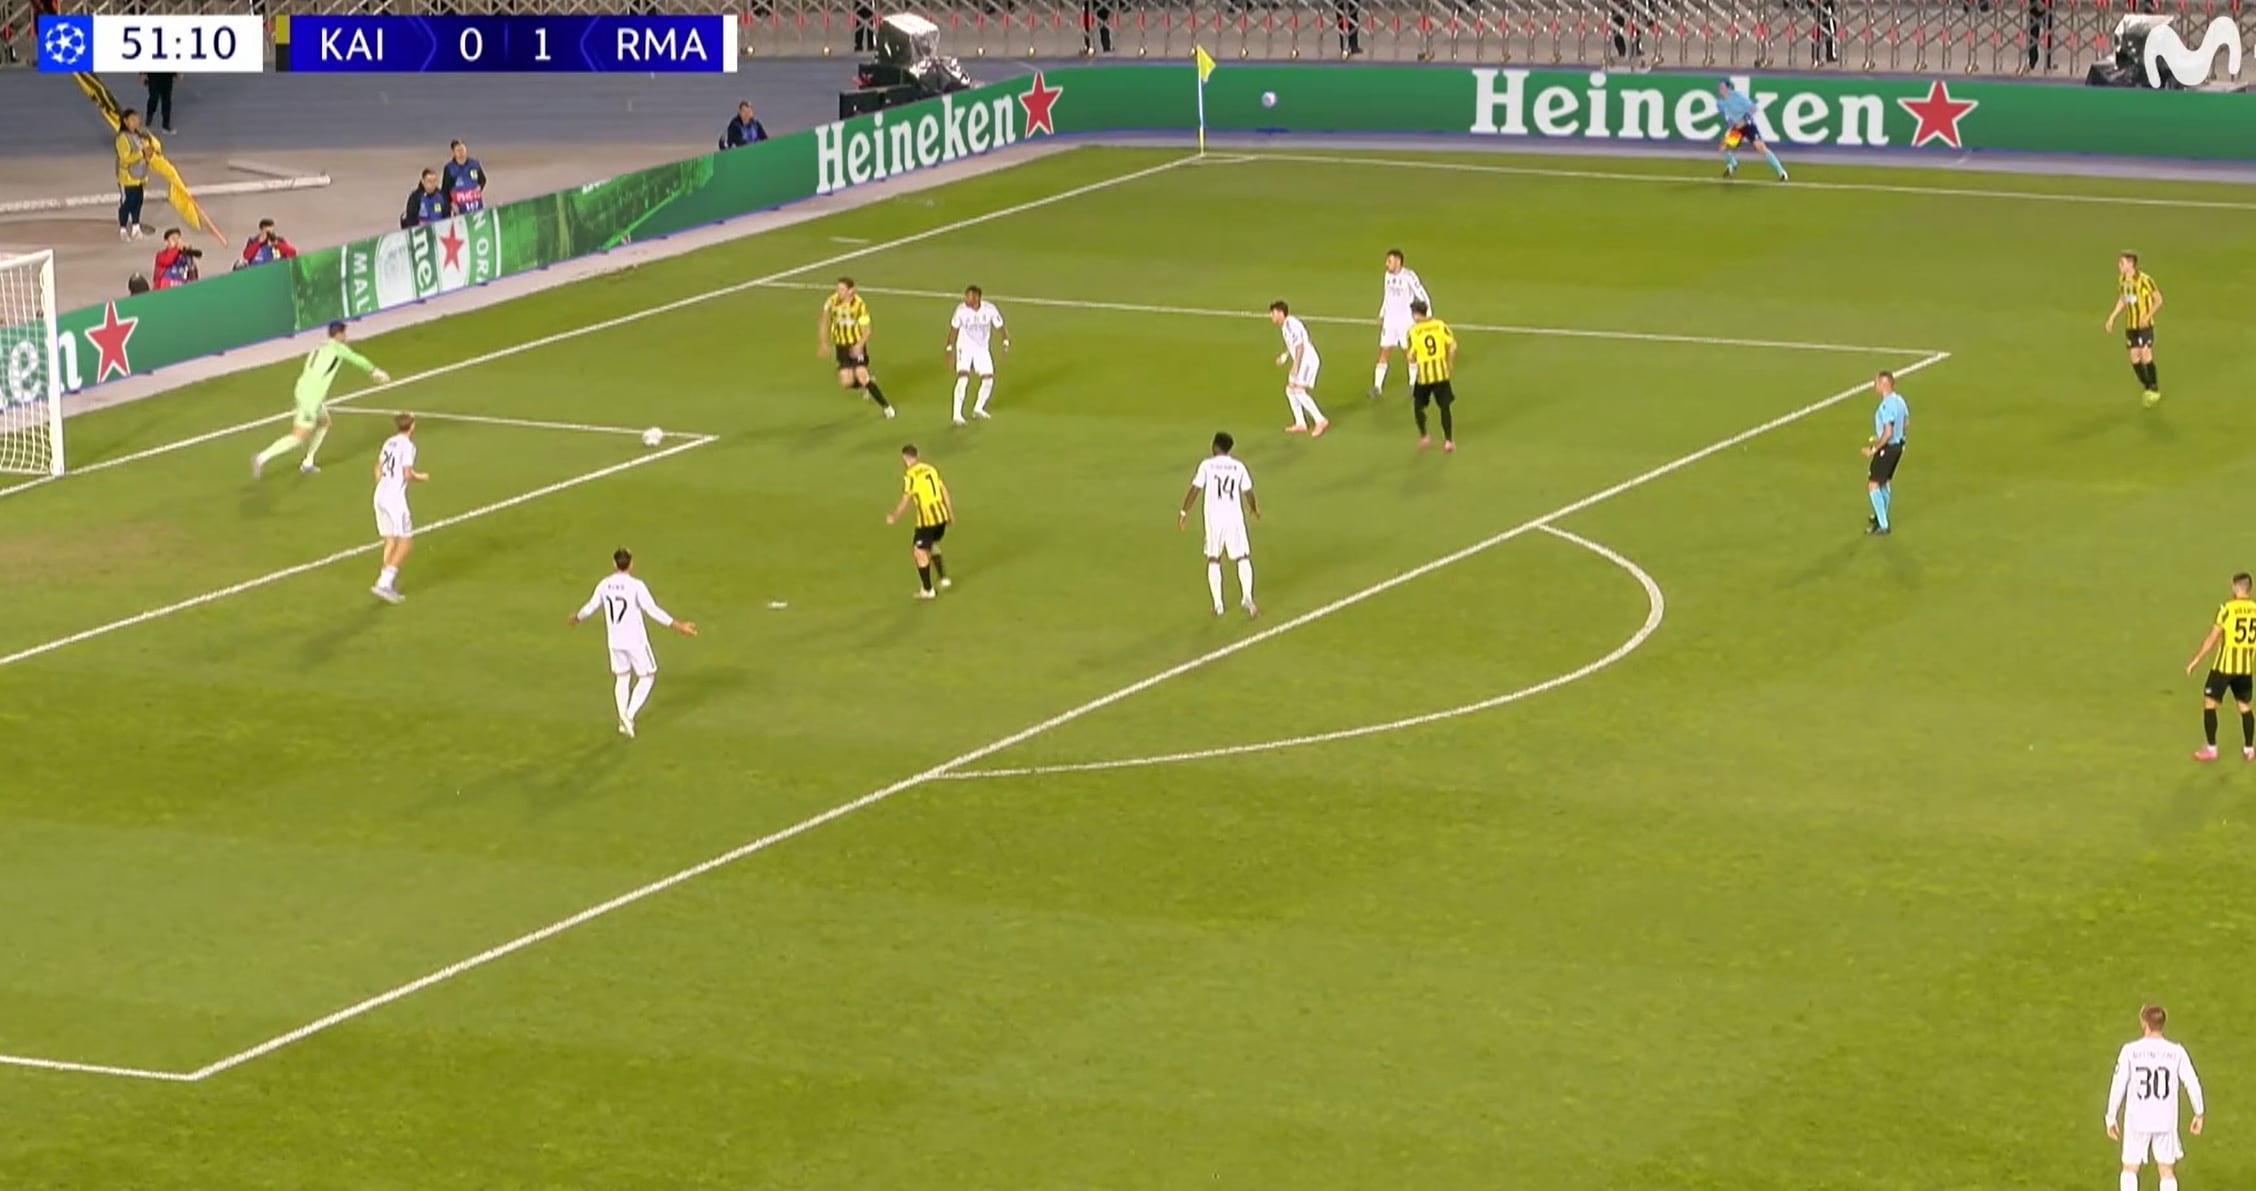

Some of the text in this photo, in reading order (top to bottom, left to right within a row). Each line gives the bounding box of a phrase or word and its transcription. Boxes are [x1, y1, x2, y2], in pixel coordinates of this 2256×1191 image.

[1470, 68, 1890, 147] Heineken
[815, 94, 1017, 195] Heineken
[1425, 335, 1437, 356] 9
[382, 450, 396, 479] 24
[1213, 474, 1235, 501] 14
[606, 595, 628, 625] 17
[2135, 1066, 2171, 1100] 30
